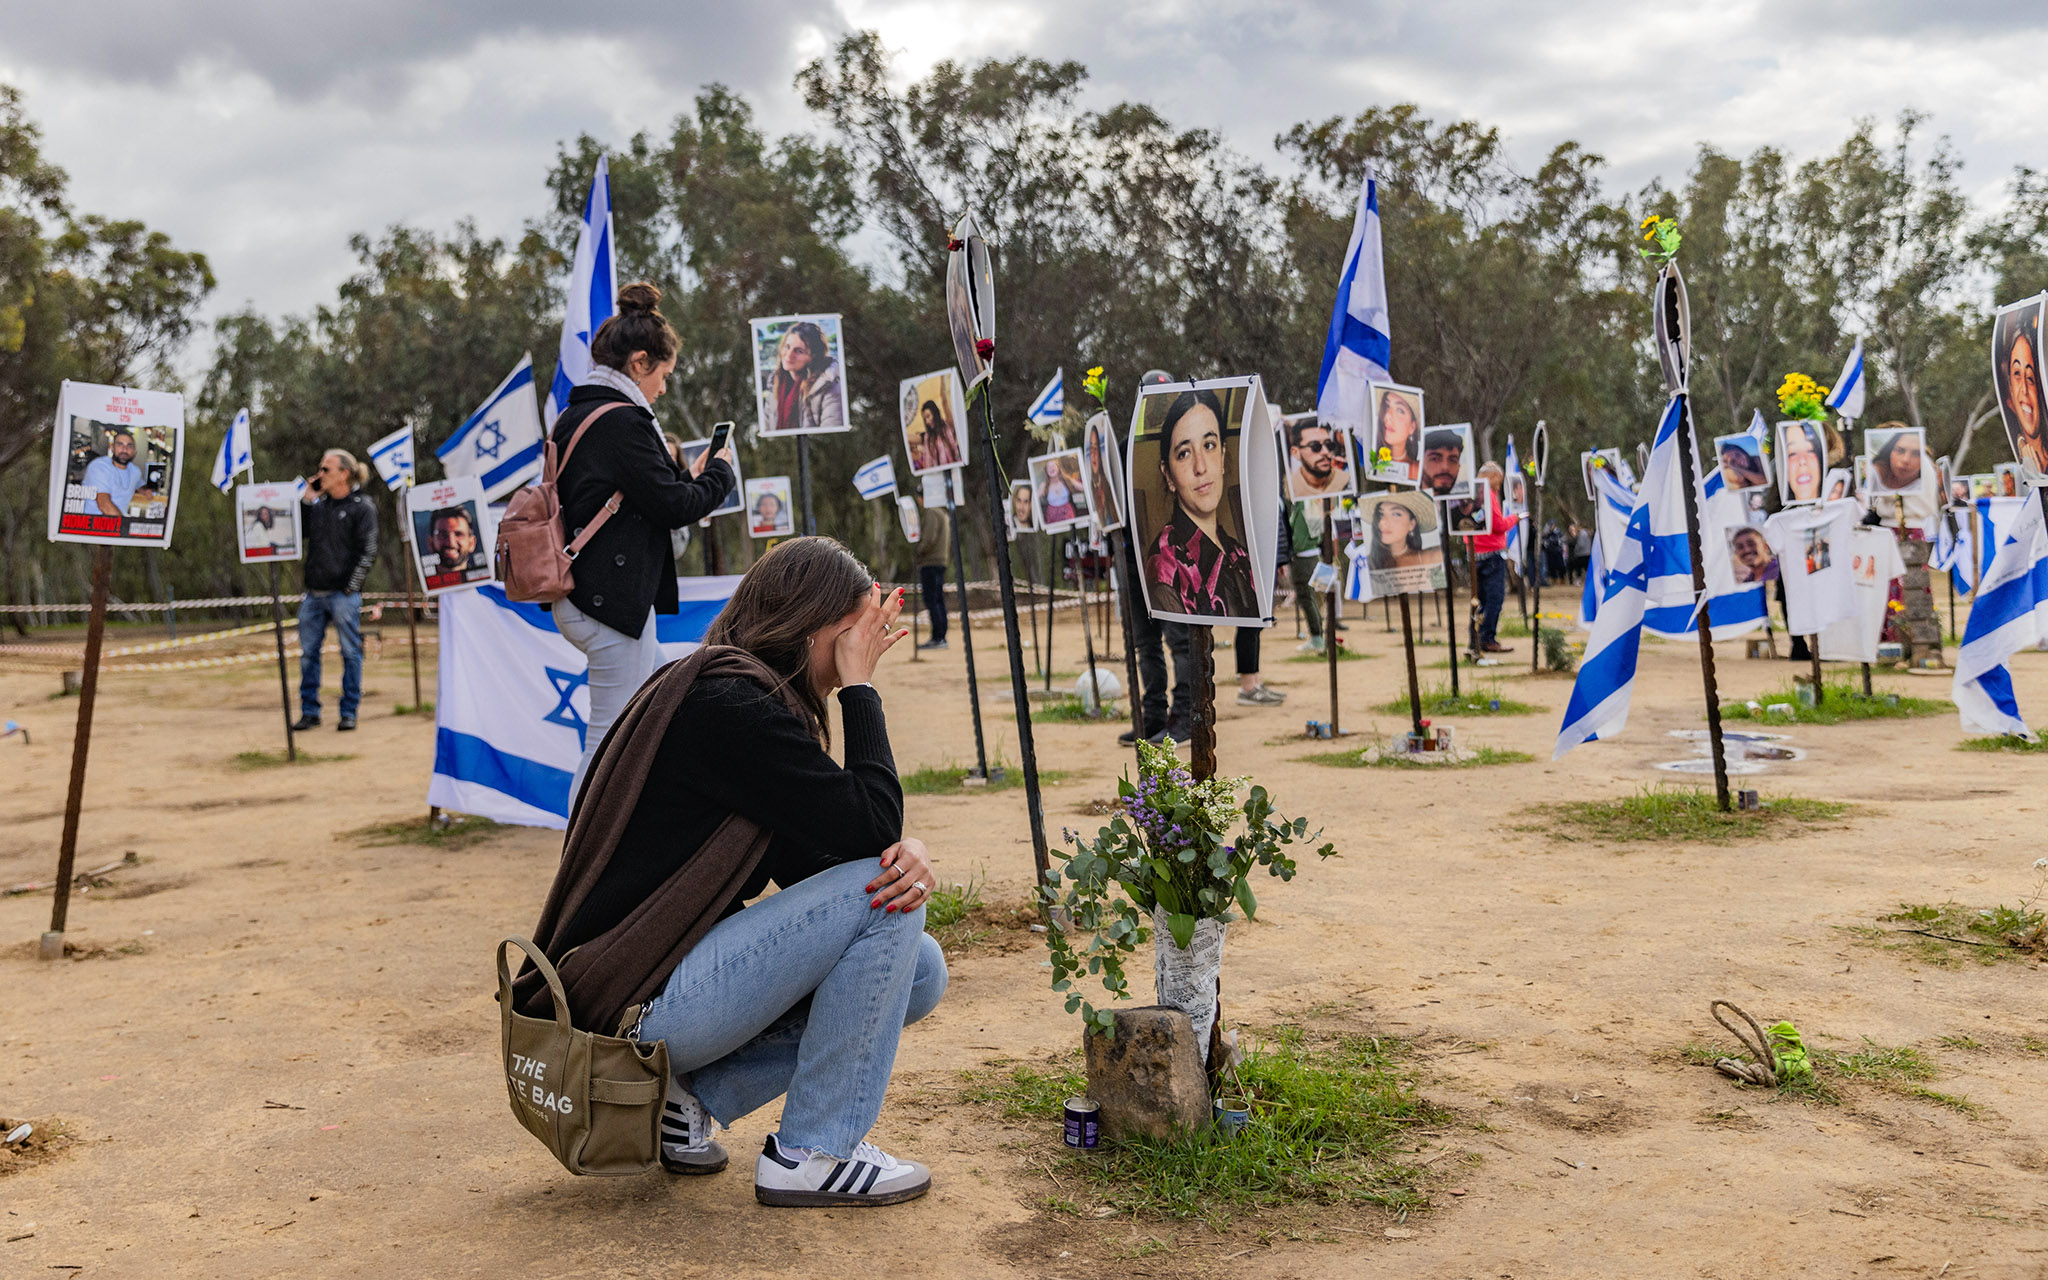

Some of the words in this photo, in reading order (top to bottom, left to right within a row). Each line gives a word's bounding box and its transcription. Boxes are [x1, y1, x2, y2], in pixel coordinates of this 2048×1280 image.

[66, 483, 98, 500] BRING
[64, 499, 85, 514] HIM
[62, 513, 90, 530] HOME
[93, 515, 122, 532] NOW!
[512, 1053, 547, 1081] THE
[532, 1086, 573, 1115] BAG
